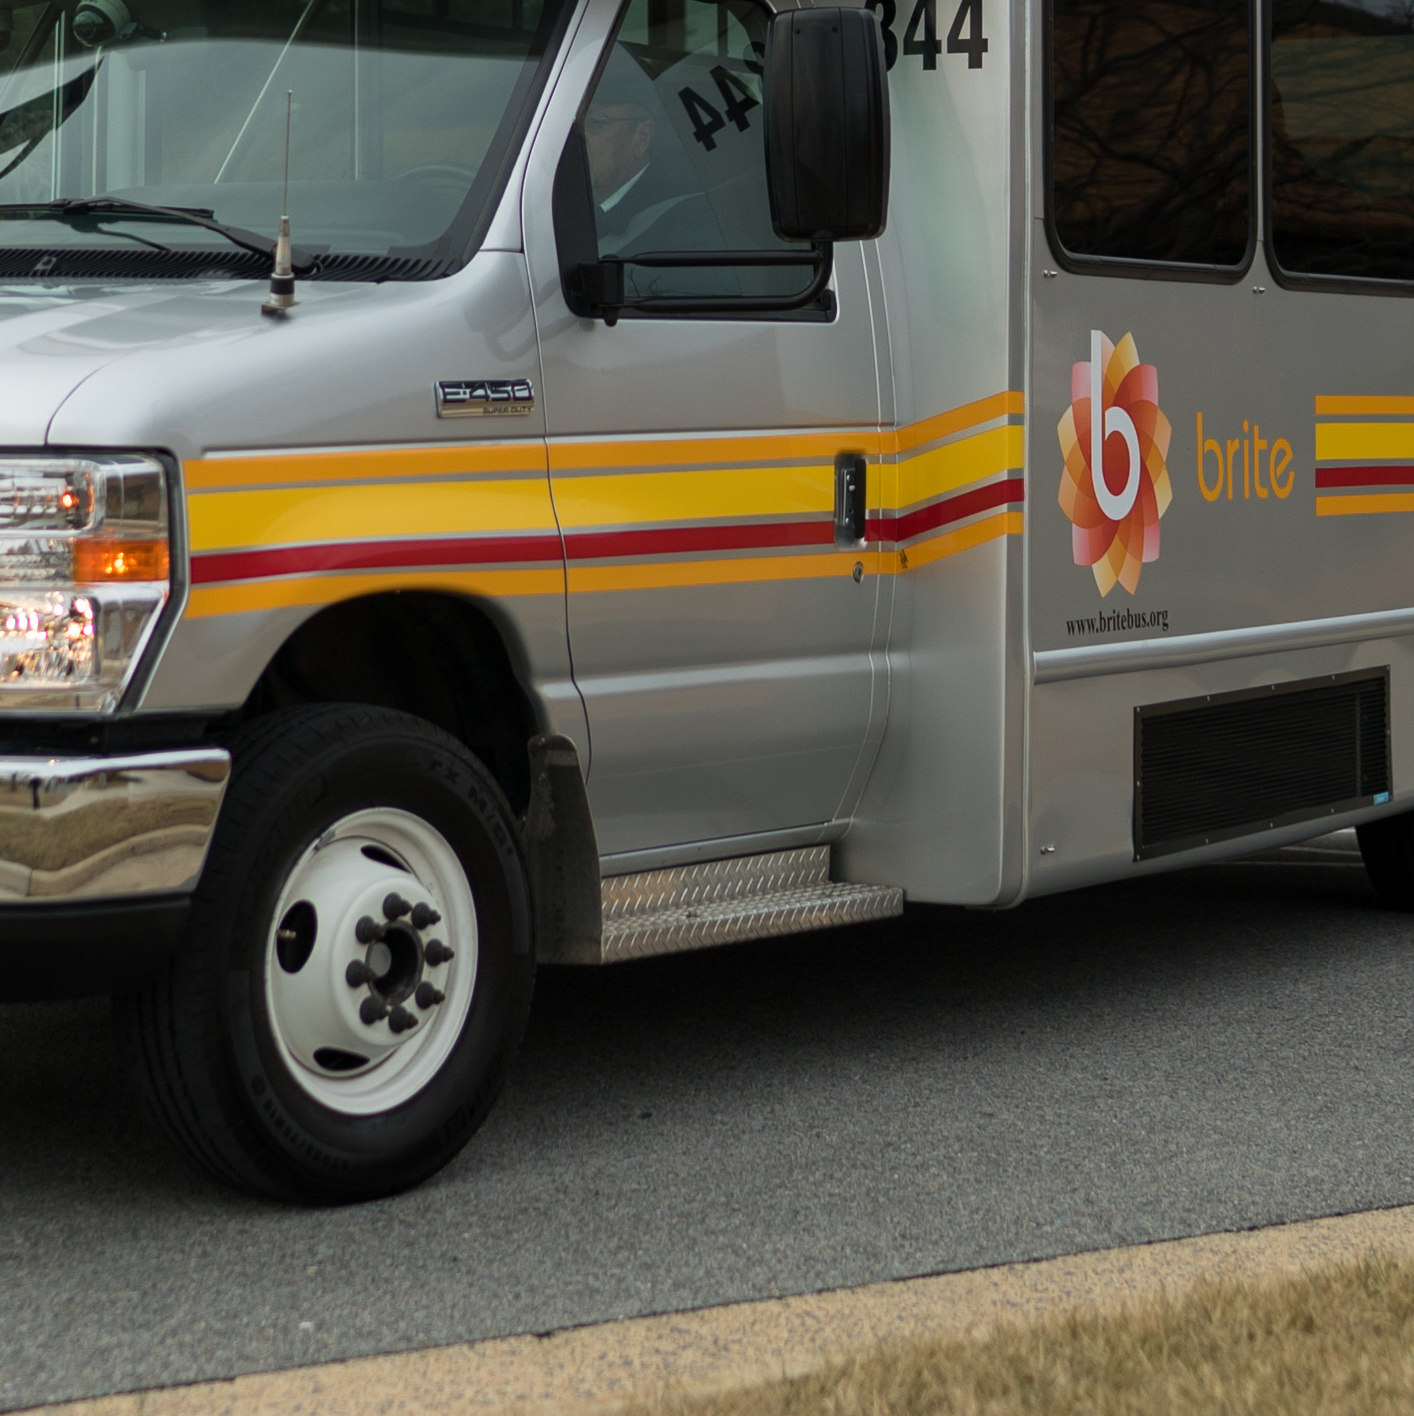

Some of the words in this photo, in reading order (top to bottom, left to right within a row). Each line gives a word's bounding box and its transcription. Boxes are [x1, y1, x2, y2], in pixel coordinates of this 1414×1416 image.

[1091, 330, 1140, 520] b
[1196, 411, 1295, 502] brite
[1066, 607, 1169, 637] www.britebus.org
